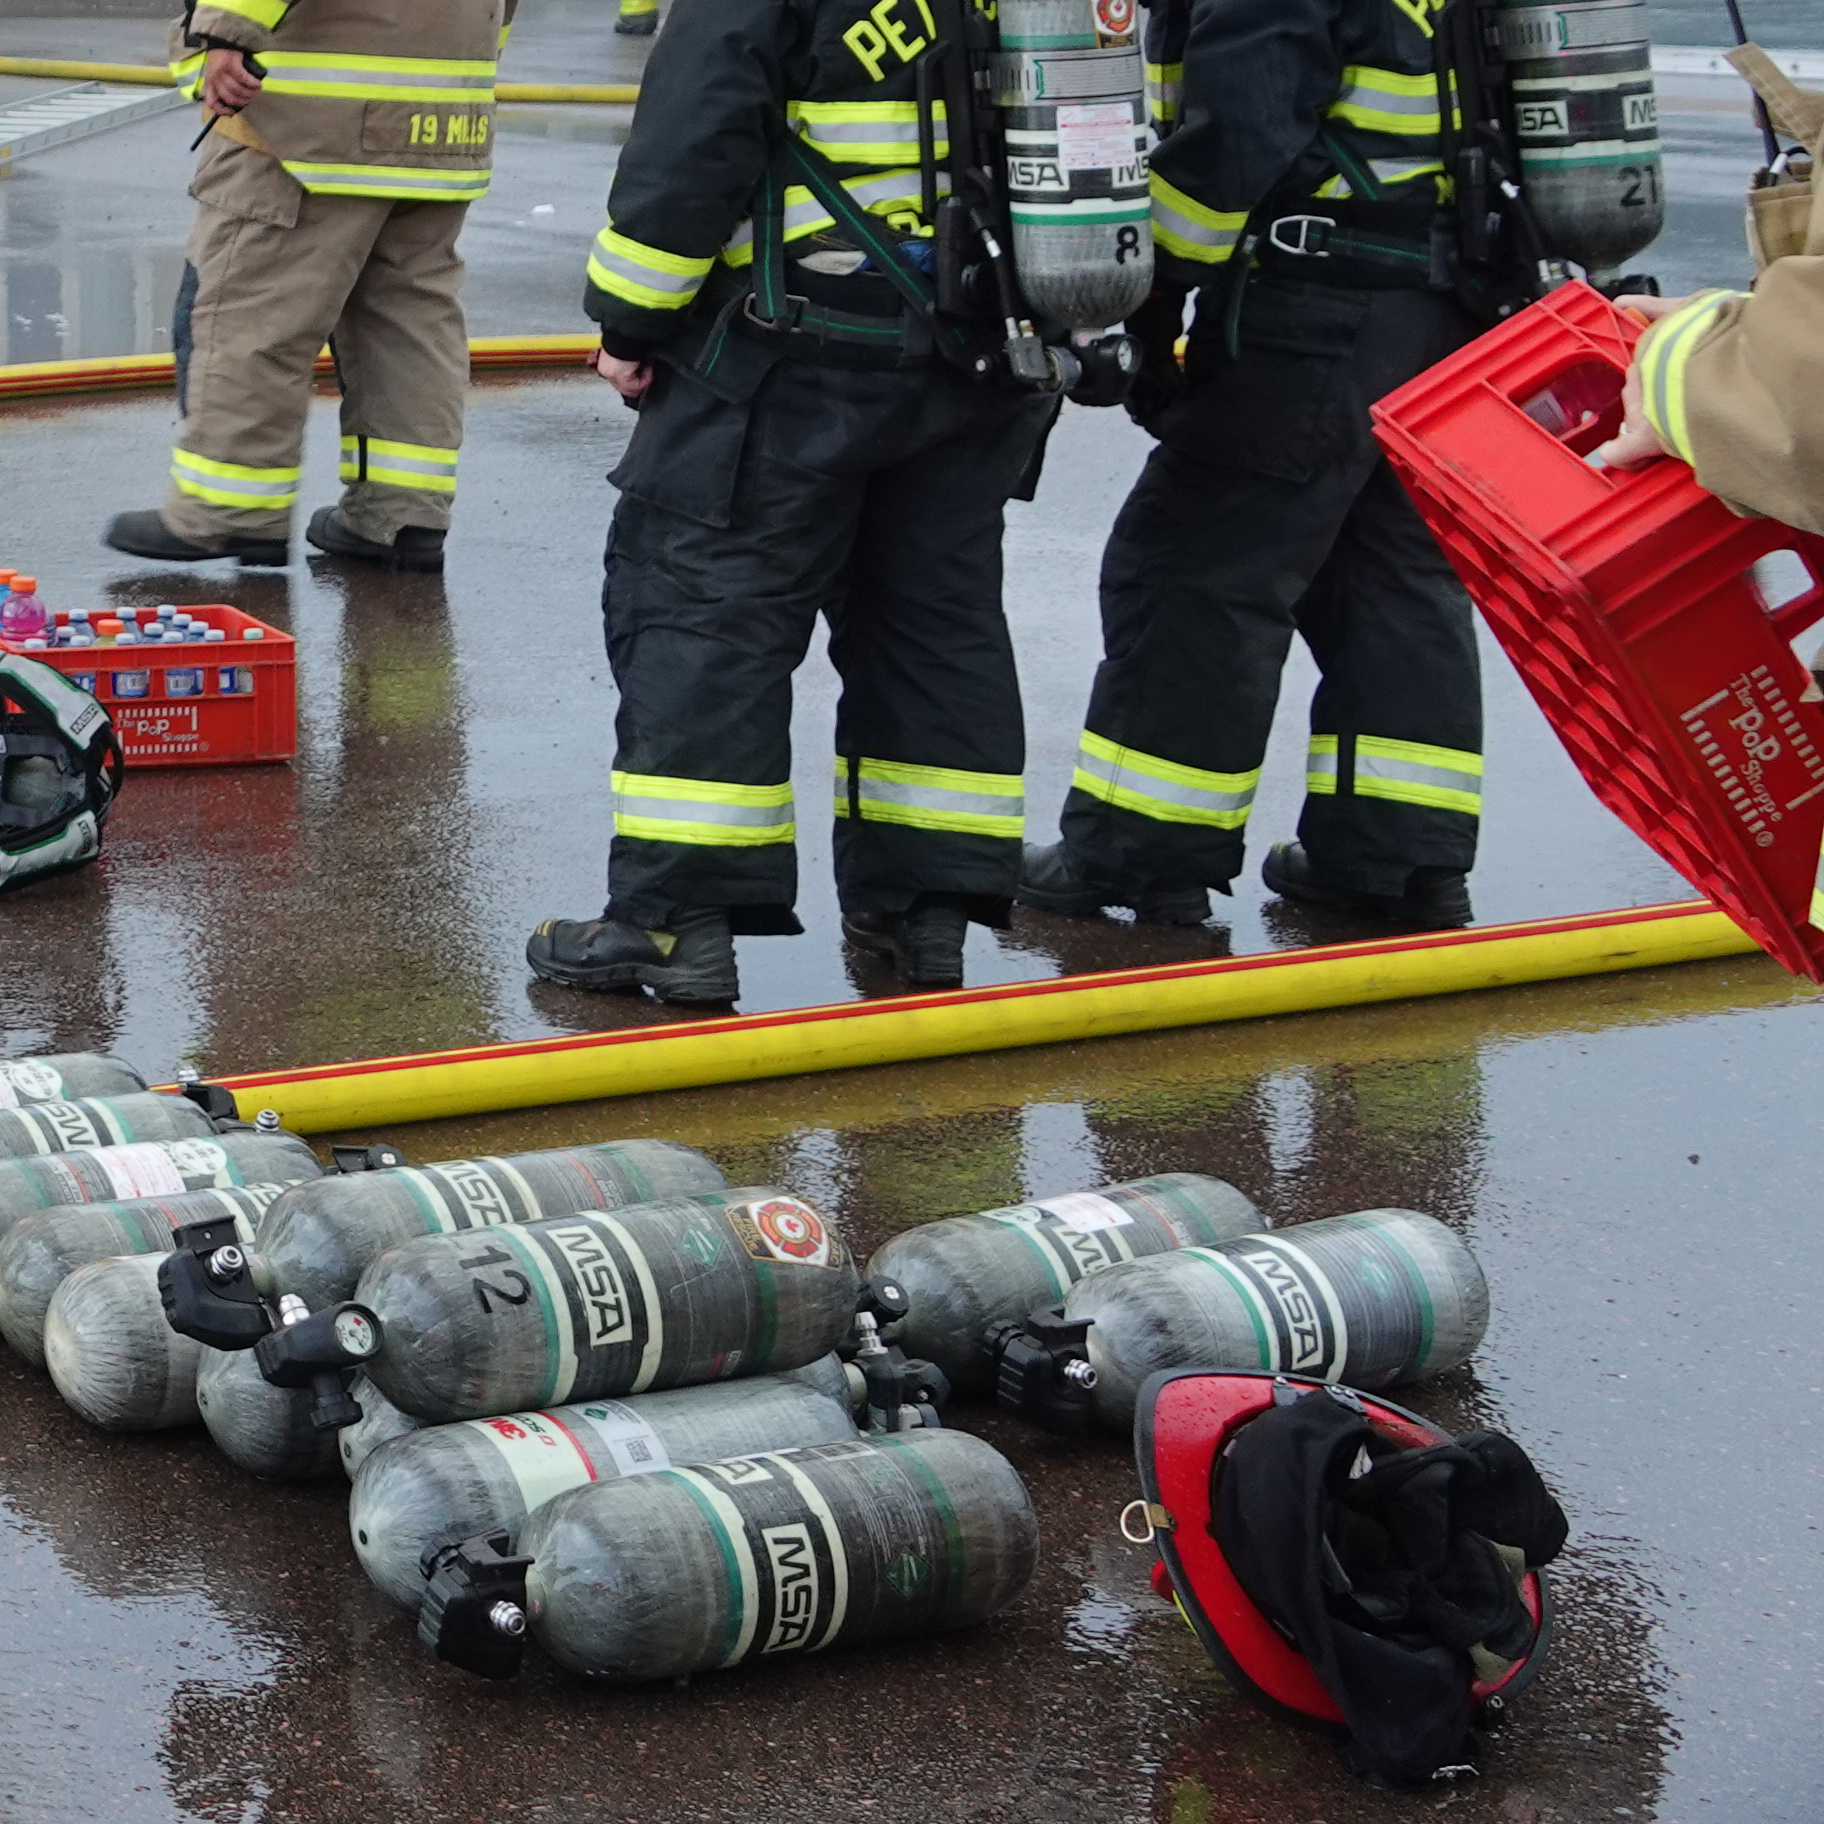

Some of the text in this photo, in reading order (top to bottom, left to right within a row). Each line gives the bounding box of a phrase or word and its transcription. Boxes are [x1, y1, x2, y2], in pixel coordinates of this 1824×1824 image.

[409, 113, 438, 145] 19
[1617, 165, 1659, 207] 21
[1115, 226, 1140, 265] 8
[1730, 673, 1756, 708] The
[1740, 759, 1783, 822] Shoppe
[44, 1104, 95, 1146] MS
[459, 1245, 532, 1314] 12
[557, 1229, 625, 1340] MSA
[1253, 1257, 1318, 1366] MSA
[767, 1536, 812, 1650] MSA
